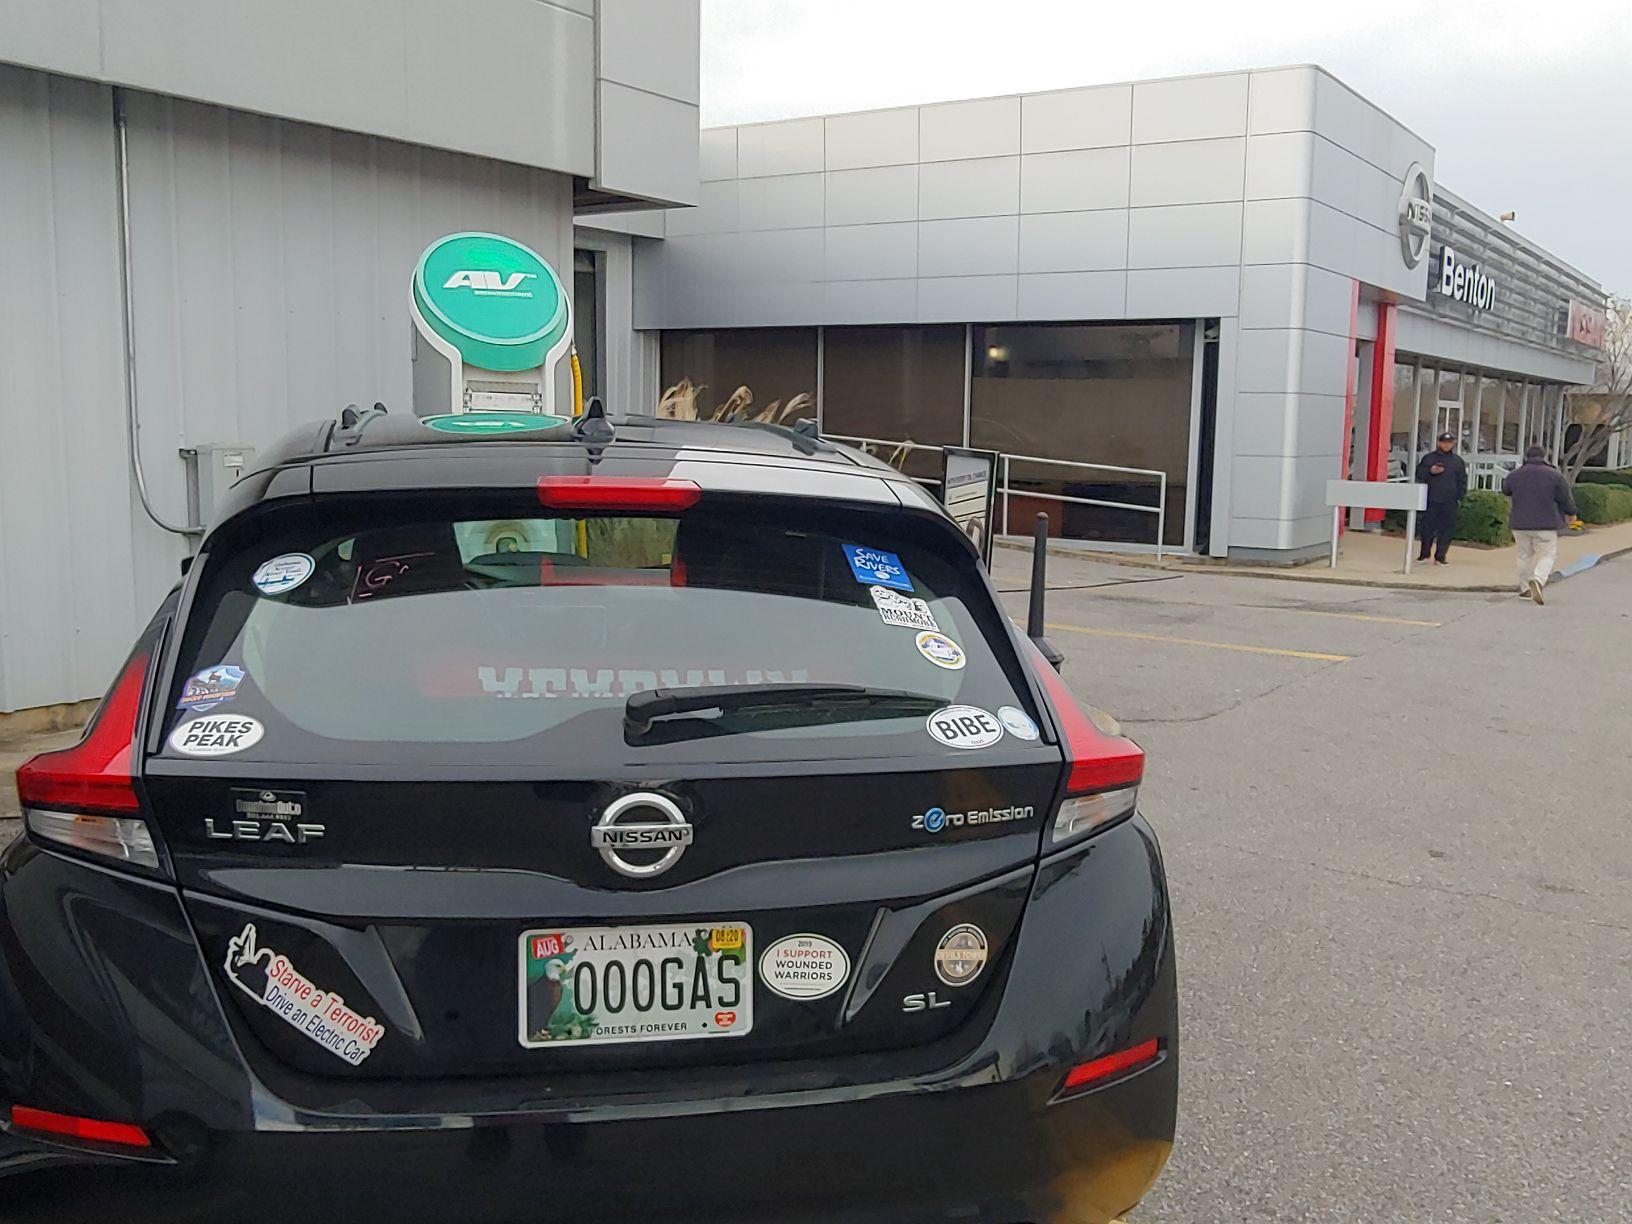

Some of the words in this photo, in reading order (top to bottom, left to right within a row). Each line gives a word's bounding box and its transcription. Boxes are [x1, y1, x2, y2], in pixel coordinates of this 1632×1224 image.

[1440, 245, 1496, 311] Benton
[855, 548, 889, 563] SAVE
[853, 556, 901, 575] RIVERS
[881, 607, 934, 621] MOUNT
[188, 721, 254, 734] PIKES
[934, 714, 996, 741] BIBE
[182, 734, 244, 748] PEAK
[967, 805, 1034, 825] Emission
[204, 818, 326, 843] LEAF
[602, 829, 683, 843] NISSAN
[536, 938, 560, 958] AUG
[583, 932, 693, 951] ALABAMA
[783, 949, 833, 959] SUPPORT
[775, 960, 833, 970] WOUNDED
[774, 971, 833, 981] WARRIORS
[270, 960, 312, 1000] Starve
[310, 993, 323, 1009] a
[322, 997, 380, 1044] Terrorist
[902, 991, 952, 1012] SL
[265, 985, 294, 1016] Drive
[291, 1009, 307, 1026] an
[305, 1014, 346, 1051] Electric
[343, 1040, 367, 1063] Car
[640, 1022, 688, 1033] FOREVER
